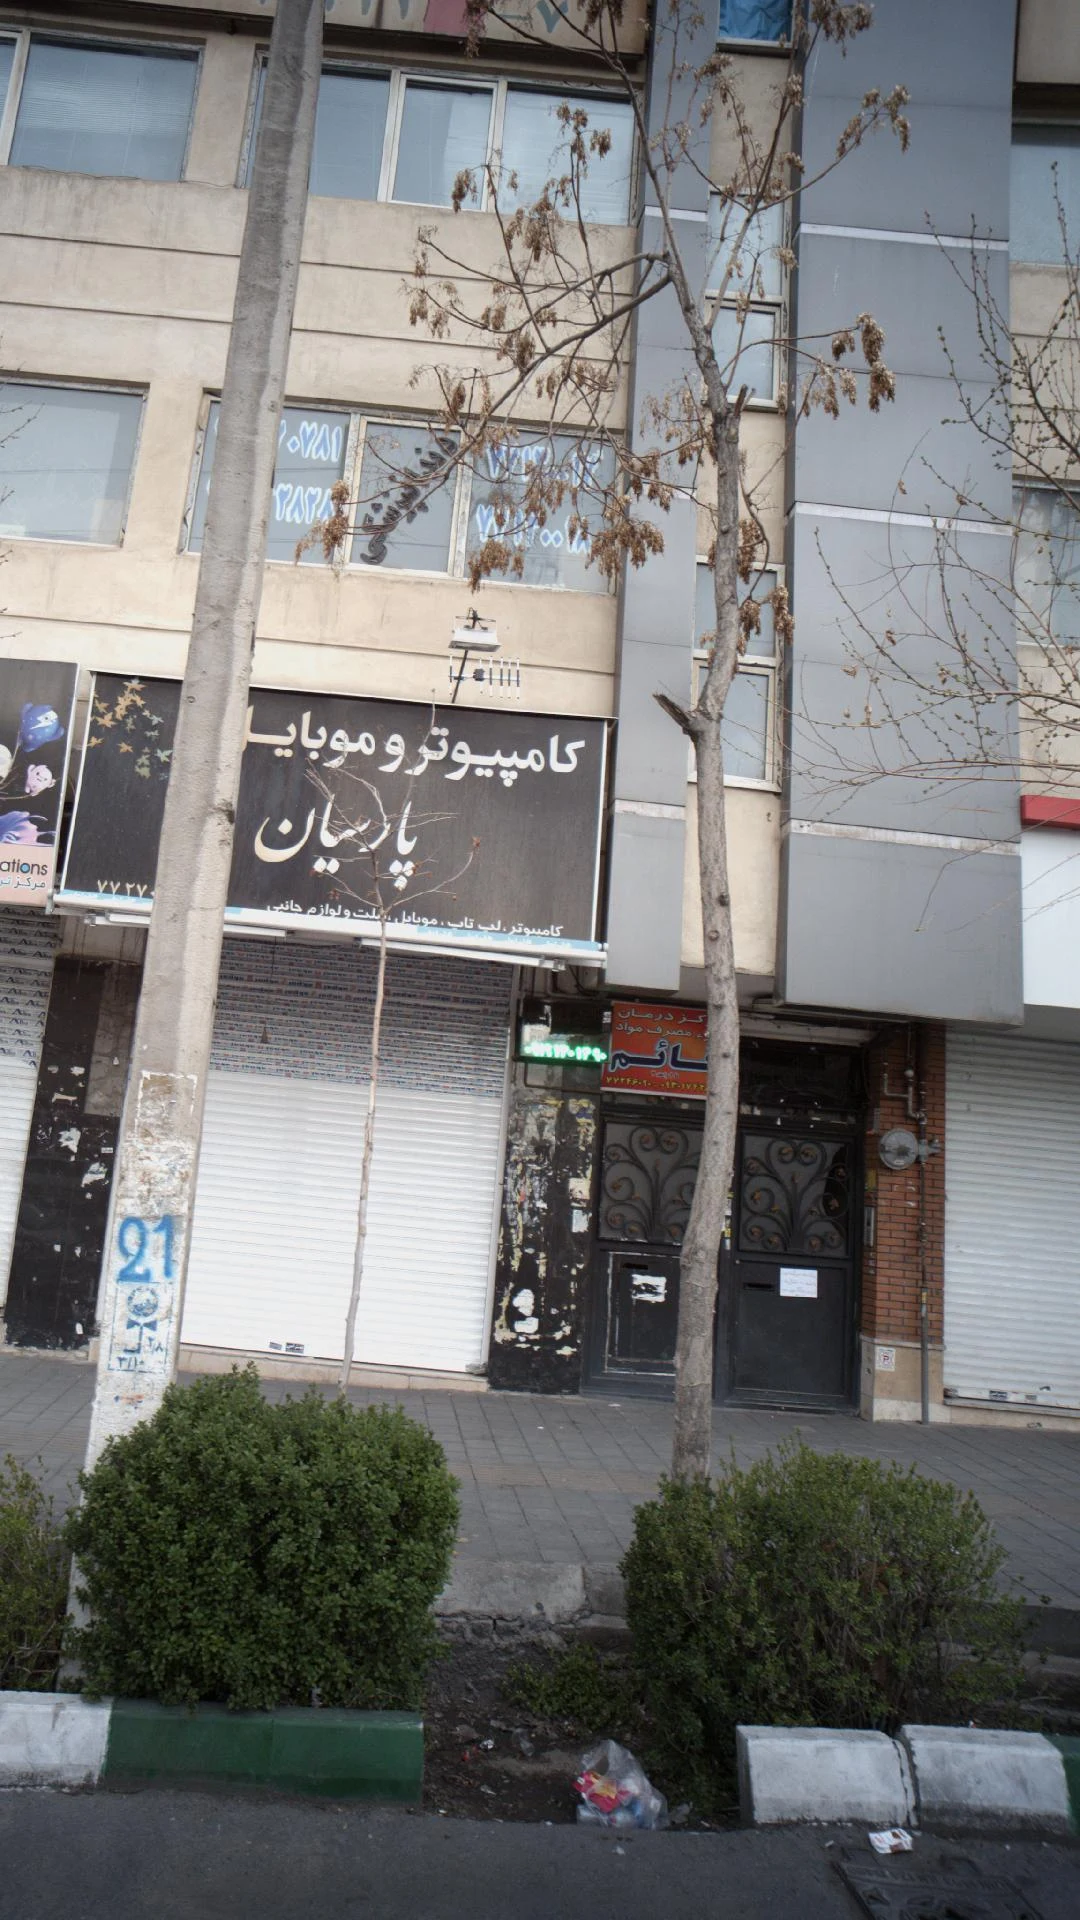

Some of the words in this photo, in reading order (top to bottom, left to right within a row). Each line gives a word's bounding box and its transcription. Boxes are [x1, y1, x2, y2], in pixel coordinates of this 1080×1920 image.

[378, 733, 406, 773] و
[405, 725, 586, 787] کامپیوتر
[254, 794, 418, 891] پارسیان
[307, 903, 342, 917] لوازم
[616, 1022, 643, 1035] مواد
[618, 1008, 674, 1021] درمان
[608, 1039, 709, 1073] ائم
